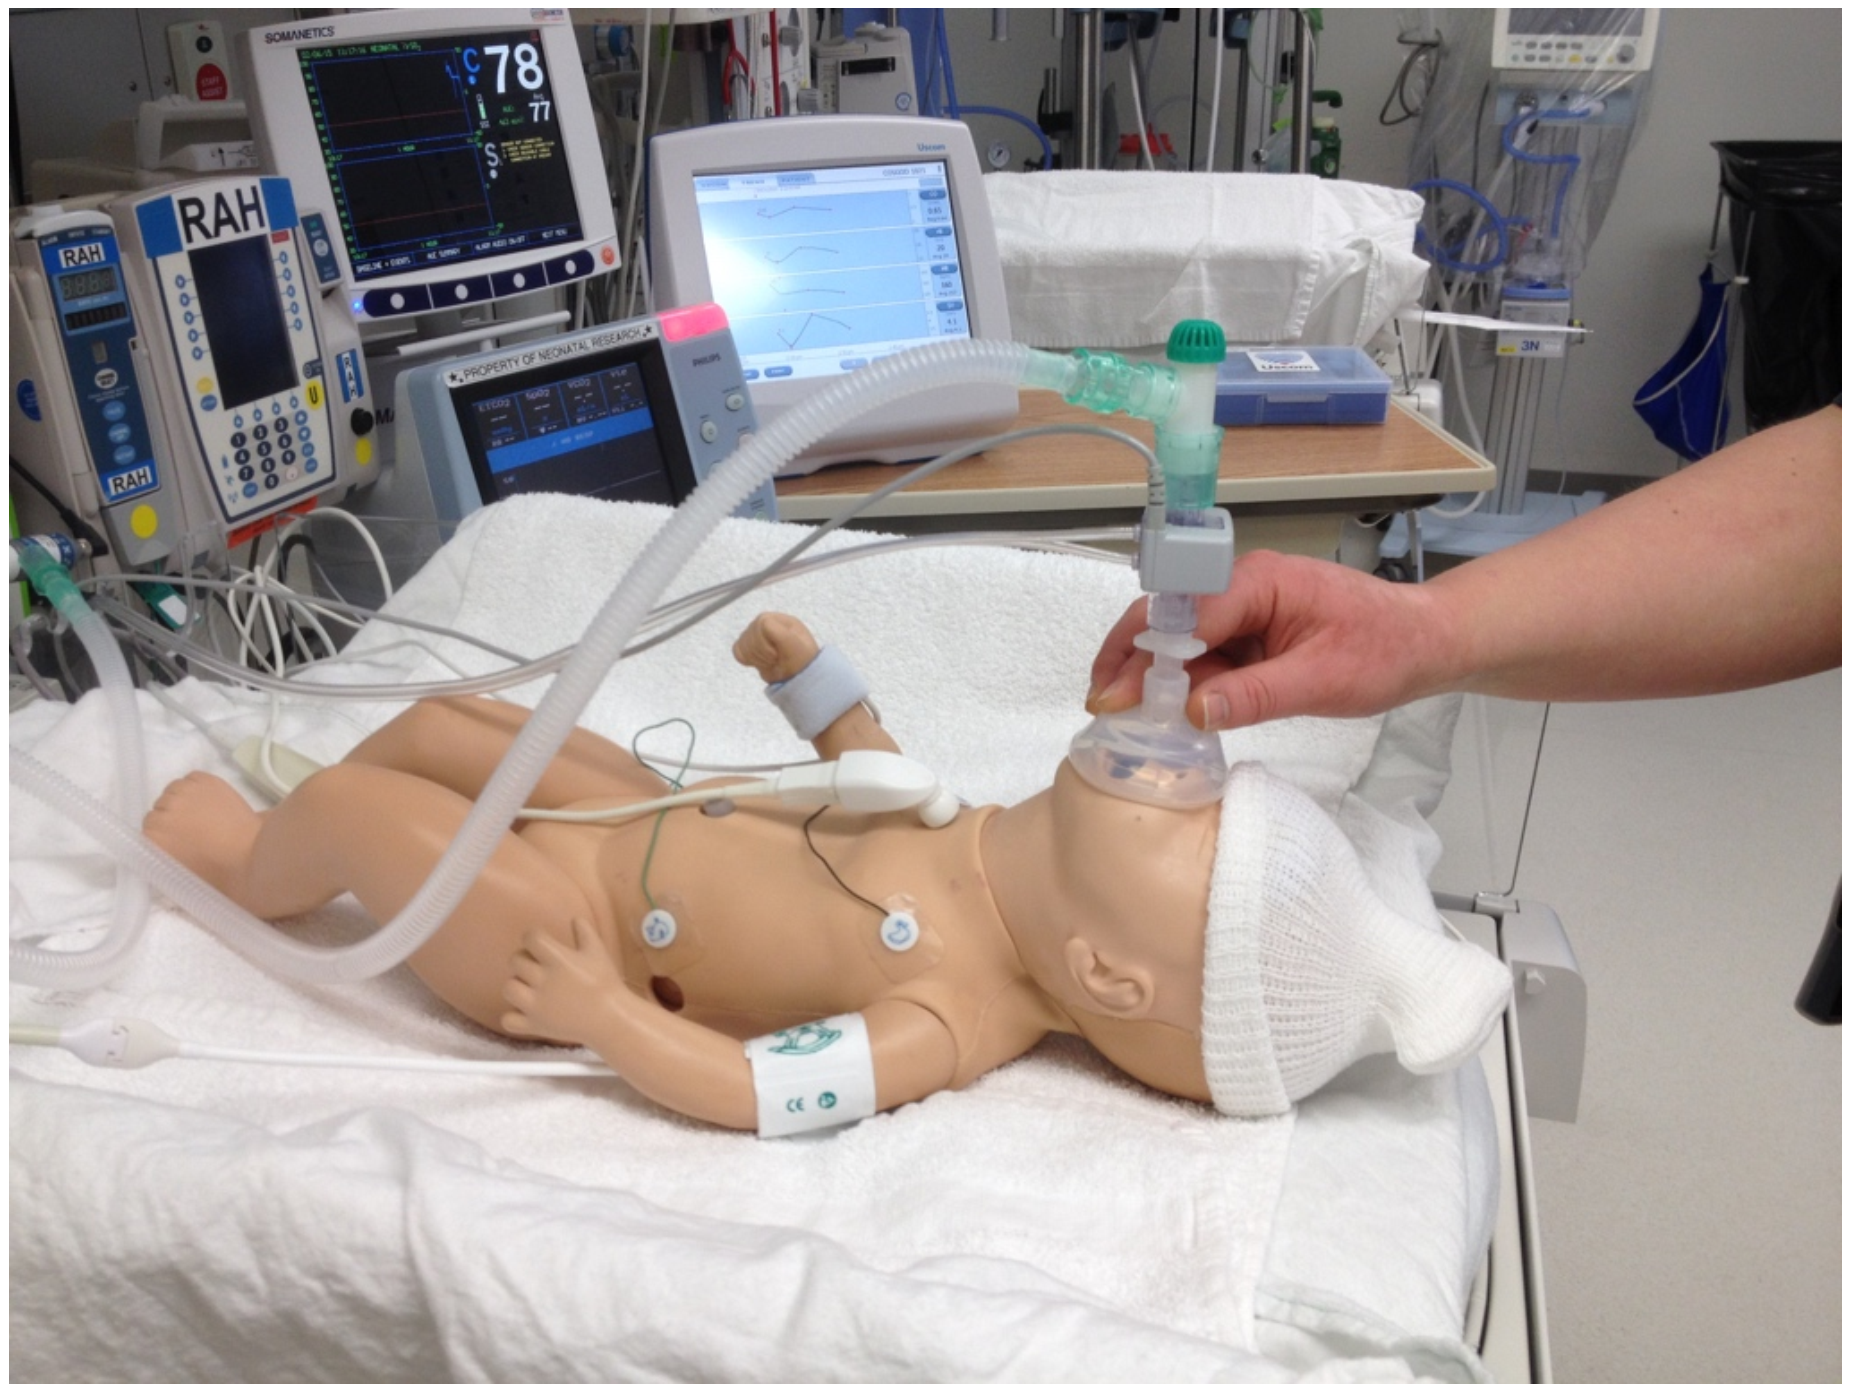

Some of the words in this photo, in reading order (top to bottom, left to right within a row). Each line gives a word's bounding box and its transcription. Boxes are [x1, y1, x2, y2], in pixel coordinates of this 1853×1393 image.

[264, 26, 334, 44] SOMANETICS
[483, 43, 544, 94] 78
[528, 100, 551, 123] 77
[917, 142, 946, 152] Uscom
[177, 185, 266, 244] RAH
[62, 244, 102, 267] RAH
[463, 357, 520, 379] PROPERTY
[522, 353, 536, 366] OF
[538, 340, 588, 361] NEONATAL
[592, 328, 641, 347] RESEARCH
[1521, 340, 1540, 351] 3N
[692, 352, 721, 367] PHILIPS
[1260, 363, 1314, 372] Uscom
[343, 355, 359, 398] RAH
[308, 385, 319, 405] U
[112, 469, 149, 493] RAH
